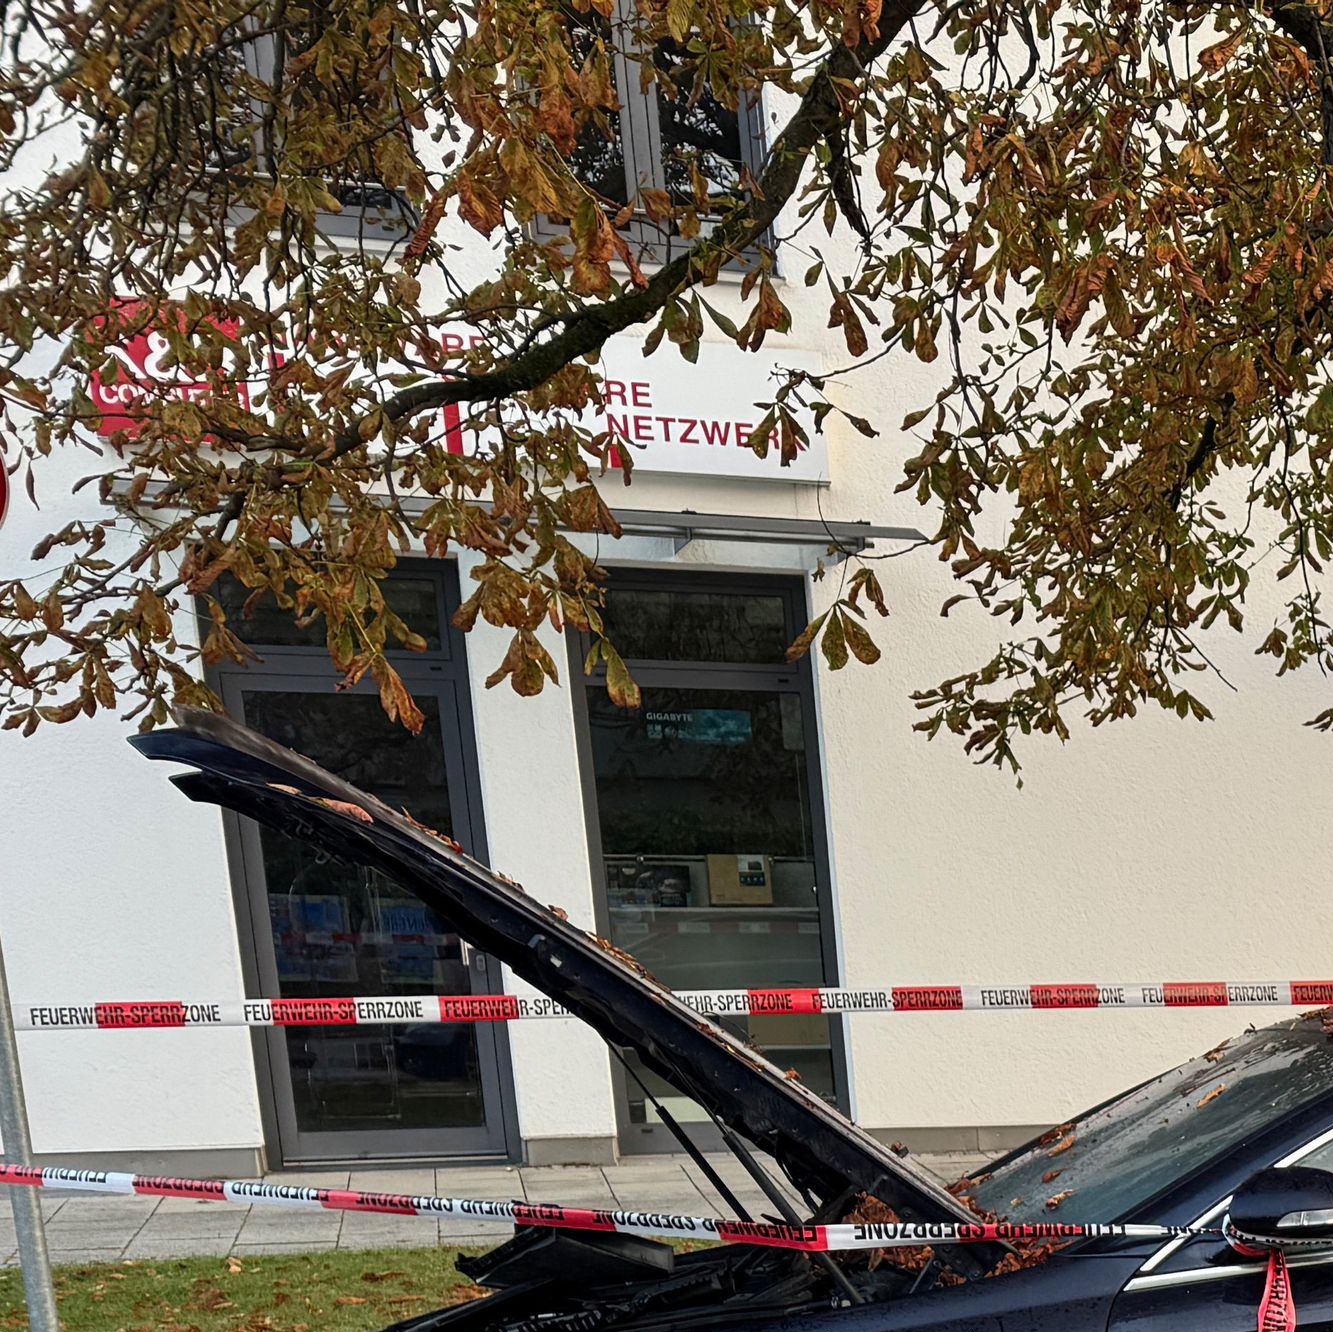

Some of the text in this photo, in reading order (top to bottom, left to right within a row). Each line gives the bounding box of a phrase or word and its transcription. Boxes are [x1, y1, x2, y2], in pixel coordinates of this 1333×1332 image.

[607, 413, 807, 452] NETZWER
[646, 712, 693, 721] GIGABYTE
[30, 1004, 221, 1026] FEUERWEHR-SPERRZONE
[244, 999, 423, 1023] FEUERWEHR-SPERRZONE
[812, 990, 963, 1010] FEUERWEHR-SPERRZONE
[981, 988, 1125, 1007] FEUERWEHR-SPERRZONE
[1142, 984, 1278, 1004] FEUERWEHR-SPERRZONE
